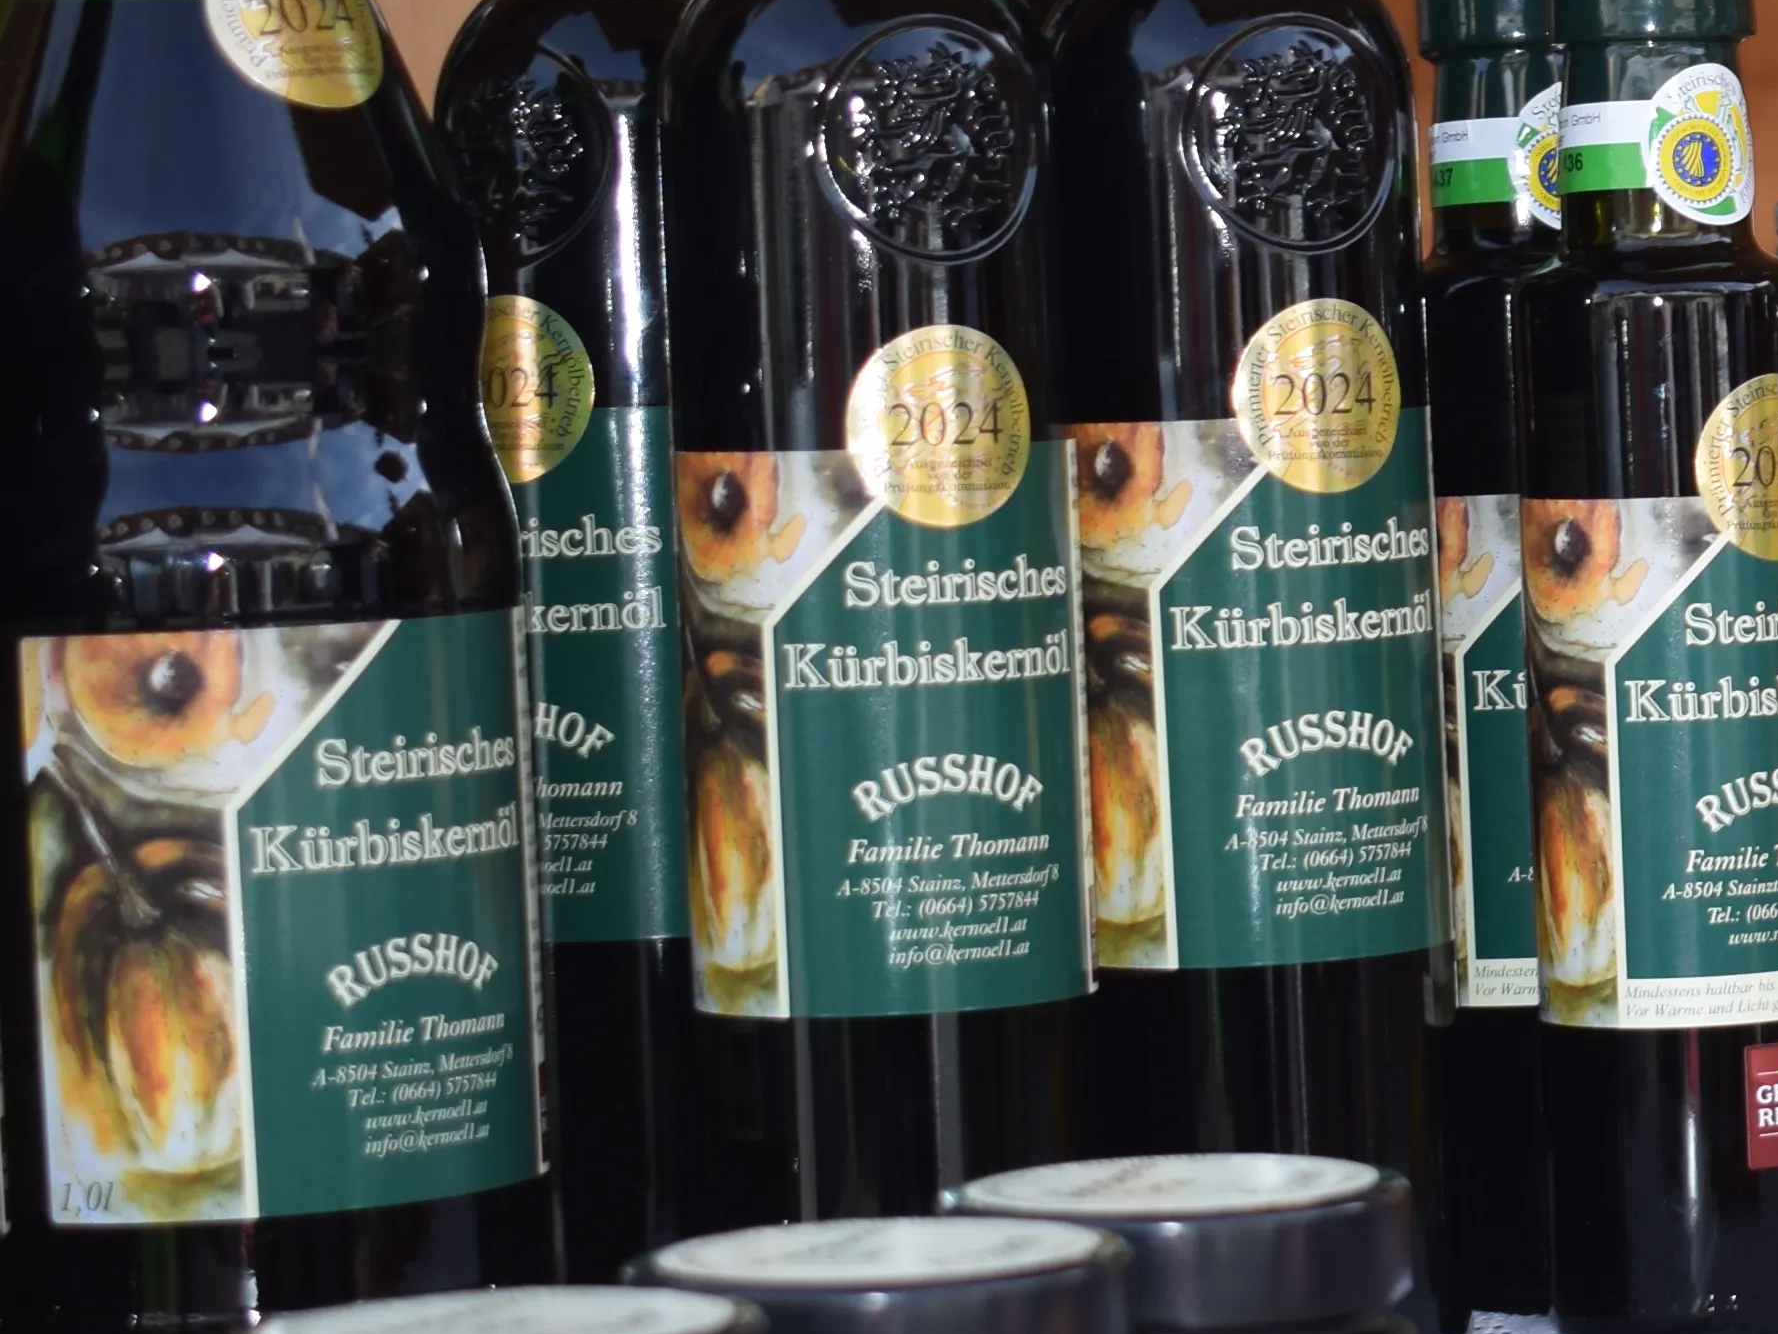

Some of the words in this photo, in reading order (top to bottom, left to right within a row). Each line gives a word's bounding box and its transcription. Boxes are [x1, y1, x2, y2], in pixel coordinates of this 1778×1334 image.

[1442, 129, 1469, 144] GmbH
[1571, 111, 1602, 127] GmbH
[489, 366, 559, 409] 024
[539, 314, 585, 438] Kernölbetrieb
[1248, 345, 1275, 447] Prämierter
[1267, 303, 1357, 343] Steirischer
[1359, 319, 1394, 444] Kernölbetrieb
[1272, 370, 1377, 416] 2024
[883, 330, 983, 372] Steirischer
[984, 344, 1025, 476] Kernölbetrieb
[888, 398, 1004, 447] 2024
[1704, 417, 1735, 517] Prämierter
[520, 513, 663, 559] risches
[1230, 517, 1430, 571] Steirisches
[845, 554, 1068, 609] Steirisches
[524, 586, 668, 633] kernöl
[1169, 589, 1433, 651] Kürbiskernöl
[783, 629, 1071, 689] Kürbiskernöl
[317, 725, 515, 787] Steirisches
[1239, 710, 1414, 777] RUSSHOF
[853, 753, 1044, 821] RUSSHOF
[1235, 790, 1326, 818] Familie
[1332, 786, 1420, 812] Thomann
[250, 800, 520, 874] Kürbiskernöl
[627, 809, 638, 826] 8
[1292, 827, 1347, 846] Stainz,
[1352, 816, 1421, 840] Mettersdorf
[544, 833, 608, 852] 5757844
[848, 836, 944, 864] Familie
[951, 833, 1050, 858] Thomann
[1259, 854, 1297, 871] Tel.:
[1303, 847, 1354, 870] (0664)
[1358, 841, 1413, 864] 5757844
[1686, 846, 1769, 873] Familie
[837, 877, 903, 898] A-8504
[908, 873, 967, 893] Stainz,
[971, 865, 1052, 890] Mettersdorf
[1052, 864, 1060, 879] 8
[1662, 880, 1723, 901] A-8504
[872, 900, 911, 919] Tel.:
[918, 896, 973, 918] (0664)
[979, 890, 1039, 912] 5757844
[1708, 906, 1741, 925] Tel.:
[327, 933, 499, 1007] RUSSHOF
[1473, 964, 1539, 979] Mindesten
[1475, 983, 1497, 997] Vor
[1625, 984, 1701, 1000] Mindestens
[1706, 982, 1755, 997] haltbar
[1625, 1004, 1649, 1018] Vor
[1655, 1002, 1704, 1018] Wärme
[1708, 1001, 1734, 1015] und
[1738, 998, 1769, 1013] Licht
[323, 1018, 415, 1052] Familie
[420, 1013, 505, 1042] Thomann
[311, 1063, 378, 1087] A-8504
[382, 1057, 435, 1079] Stainz,
[439, 1045, 506, 1073] Mettersdorf
[348, 1087, 386, 1108] Tel.:
[392, 1080, 441, 1105] (0664)
[446, 1071, 497, 1096] 5757844
